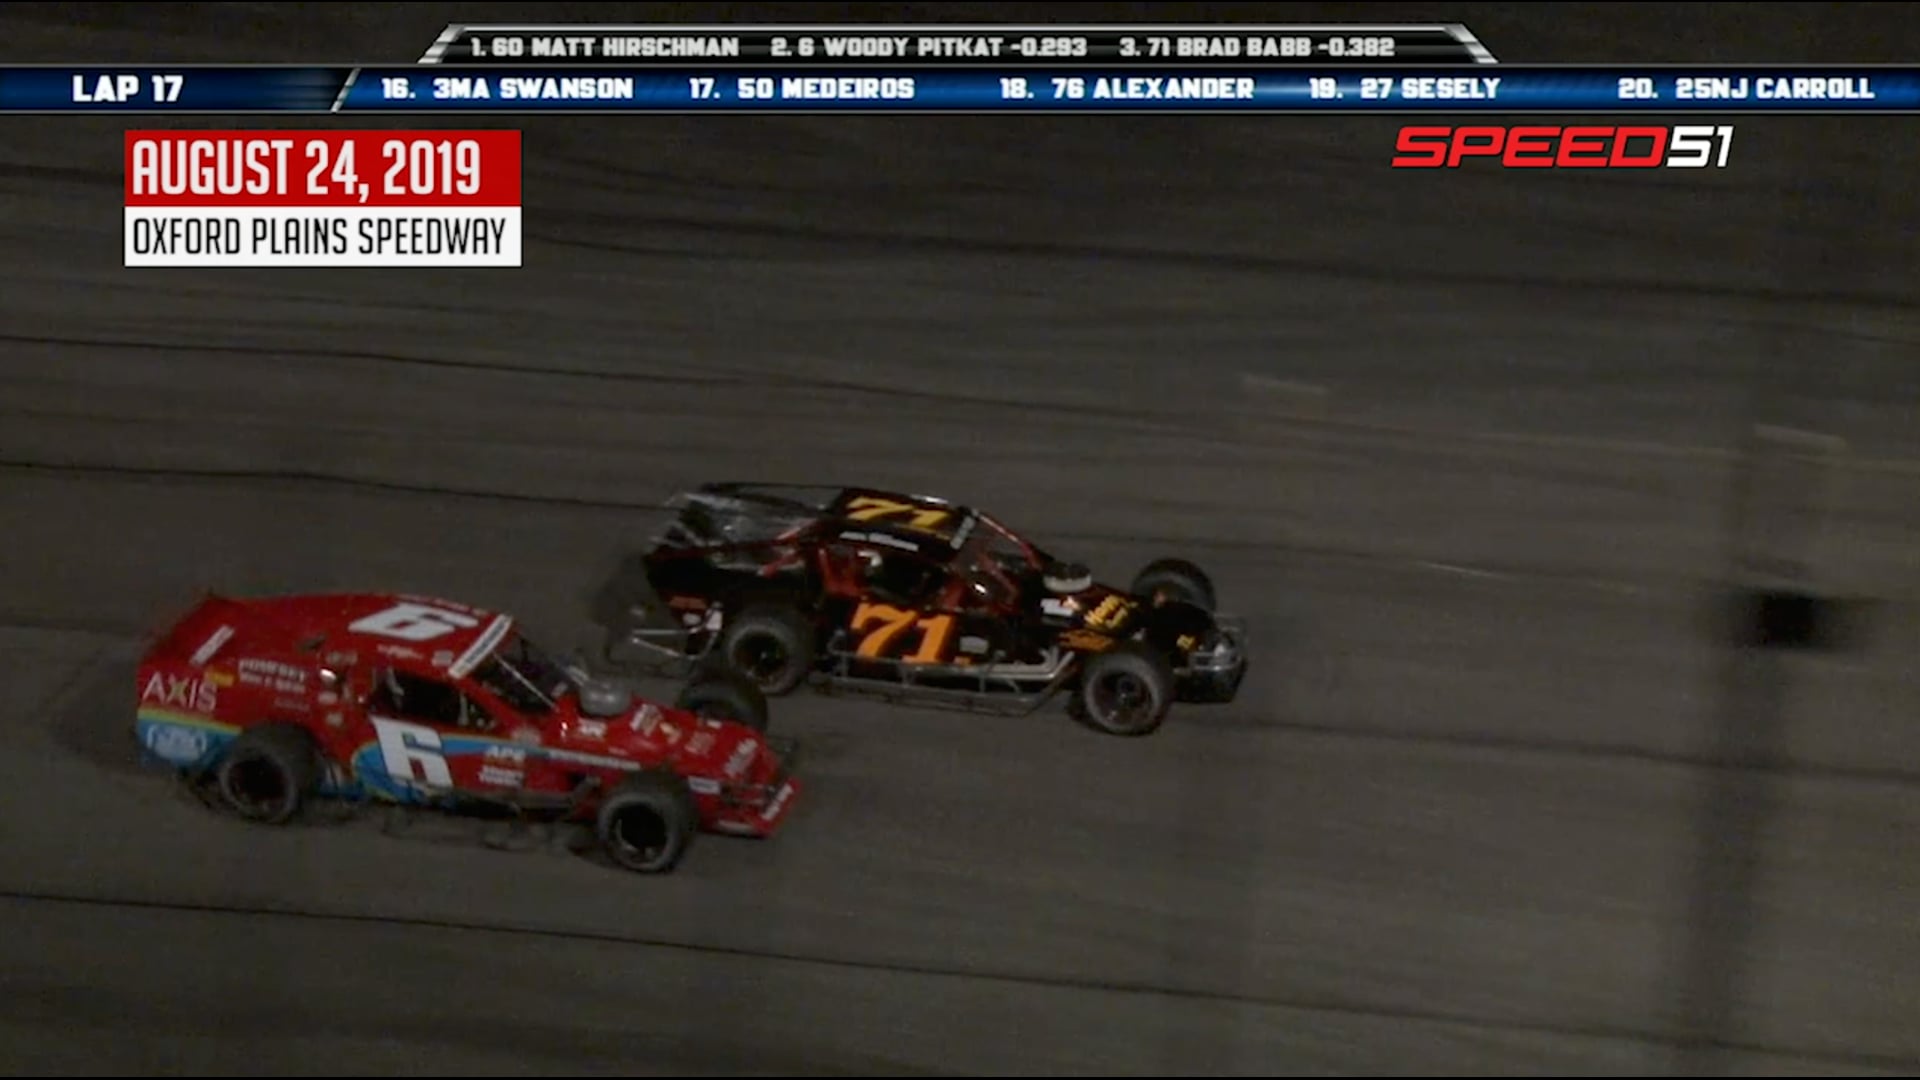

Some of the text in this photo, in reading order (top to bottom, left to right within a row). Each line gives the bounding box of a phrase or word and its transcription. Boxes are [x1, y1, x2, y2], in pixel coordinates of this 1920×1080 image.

[844, 495, 952, 529] 71
[348, 602, 479, 641] 6
[849, 601, 959, 666] 71
[141, 670, 218, 713] AXIS
[369, 713, 454, 790] 6
